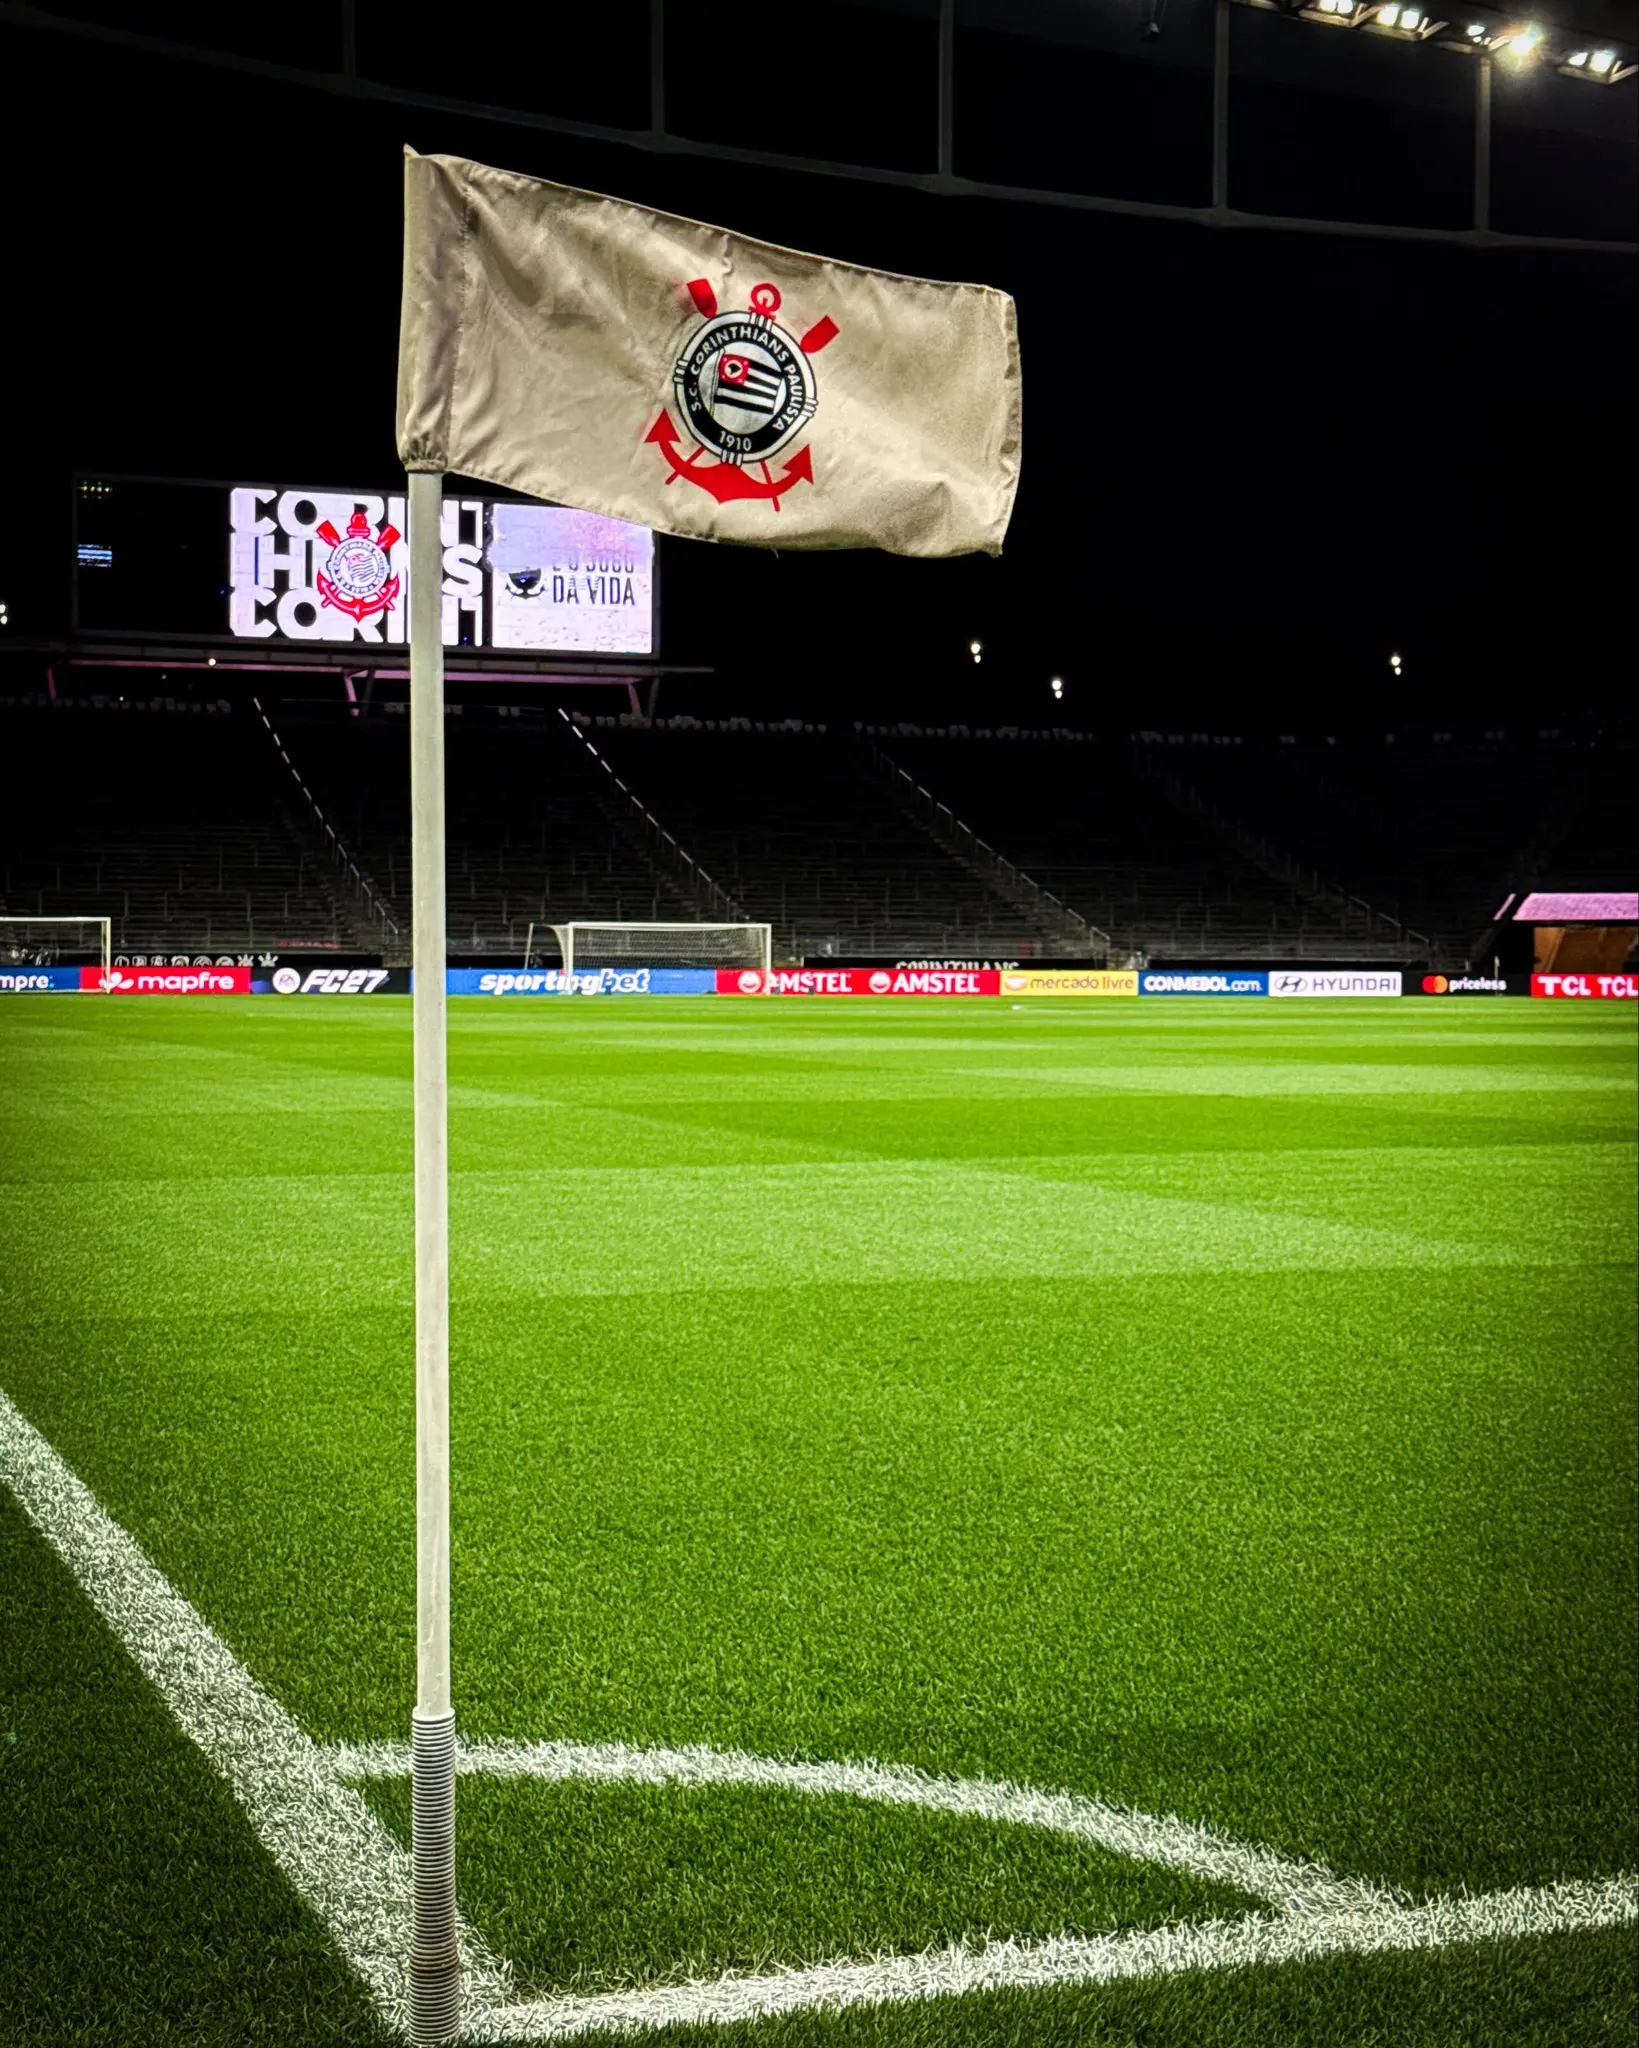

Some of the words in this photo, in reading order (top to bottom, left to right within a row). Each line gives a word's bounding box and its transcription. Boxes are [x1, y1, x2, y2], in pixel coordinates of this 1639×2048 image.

[691, 325, 791, 376] CORINTHIANS
[771, 363, 804, 432] PAULISTA
[719, 430, 752, 452] 1910
[553, 575, 580, 605] DA
[586, 576, 636, 606] VIDA
[138, 972, 234, 993] mapfre
[300, 969, 390, 993] FC27
[479, 968, 650, 995] sportingbet
[762, 972, 852, 993] AMSTEL
[892, 972, 980, 993] AMSTEL
[1030, 976, 1100, 989] mercado
[1103, 976, 1134, 989] livre
[1312, 977, 1397, 992] HYUNDAI
[1449, 976, 1508, 993] priceless
[1537, 976, 1592, 996] TCL
[1597, 976, 1638, 997] TCL
